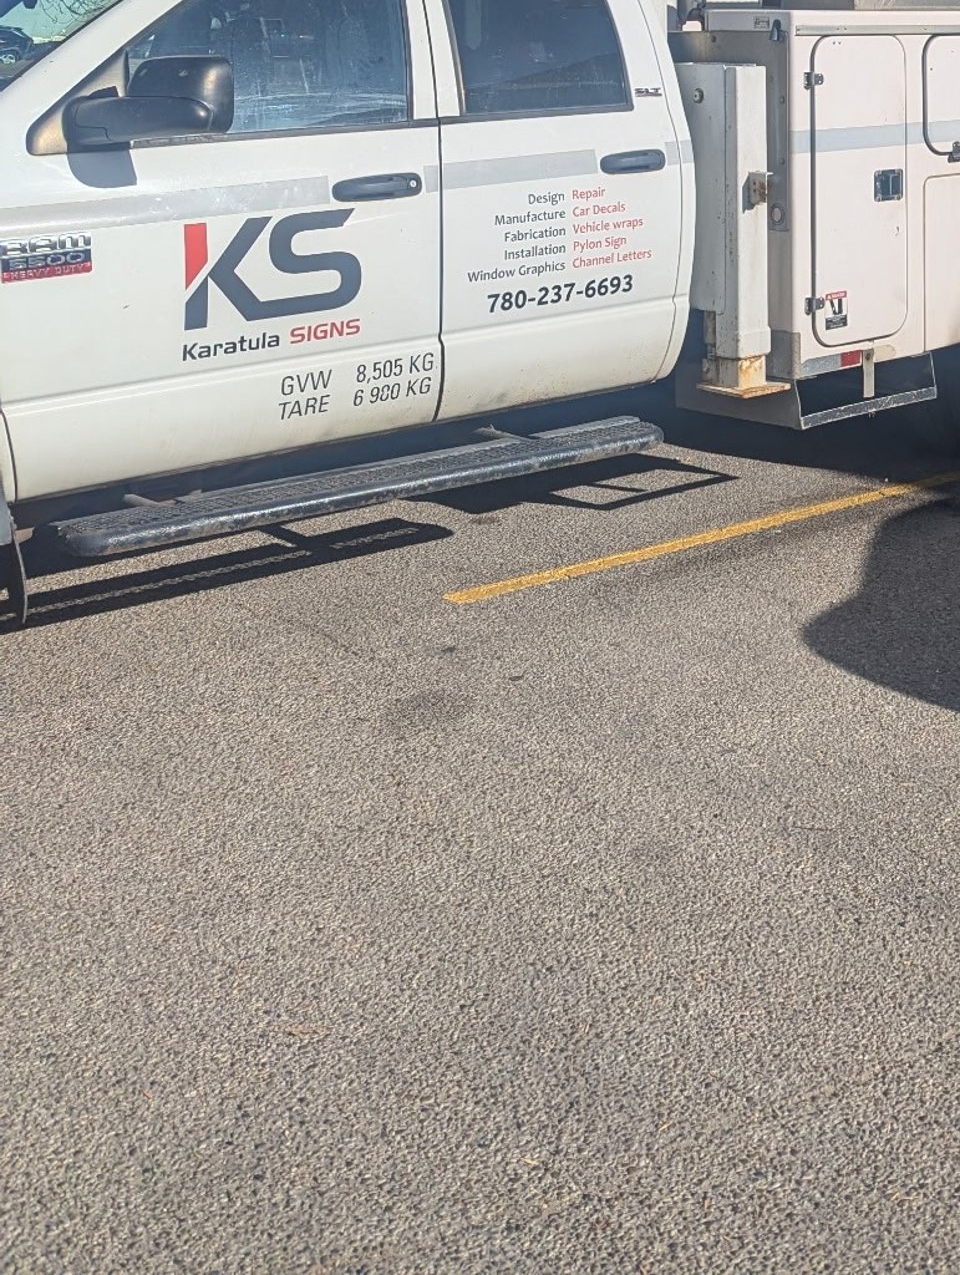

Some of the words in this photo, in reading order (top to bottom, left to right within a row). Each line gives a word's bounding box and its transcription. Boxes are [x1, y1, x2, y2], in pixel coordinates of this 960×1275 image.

[528, 192, 565, 206] Design
[572, 187, 606, 202] Repair
[494, 209, 566, 226] Manufacture
[572, 205, 590, 217] Car
[593, 201, 626, 215] Decals
[504, 226, 566, 242] Fabrication
[573, 221, 610, 234] Vehicle
[611, 218, 643, 231] wraps
[504, 243, 566, 260] Installation
[573, 239, 603, 252] Pylon
[604, 236, 627, 249] Sign
[9, 252, 86, 271] 5500
[572, 253, 615, 269] Channel
[617, 249, 652, 263] Letters
[11, 268, 50, 280] HEAVY
[183, 208, 363, 331] KS
[467, 267, 516, 283] Window
[518, 260, 566, 277] Graphics
[487, 274, 634, 314] 780-237-6693
[182, 332, 280, 362] Karatula
[290, 319, 361, 344] SIGNS
[281, 369, 333, 396] GVW
[356, 358, 404, 384] 8,505
[409, 352, 434, 374] KG
[278, 394, 331, 420] TARE
[406, 376, 432, 397] KG
